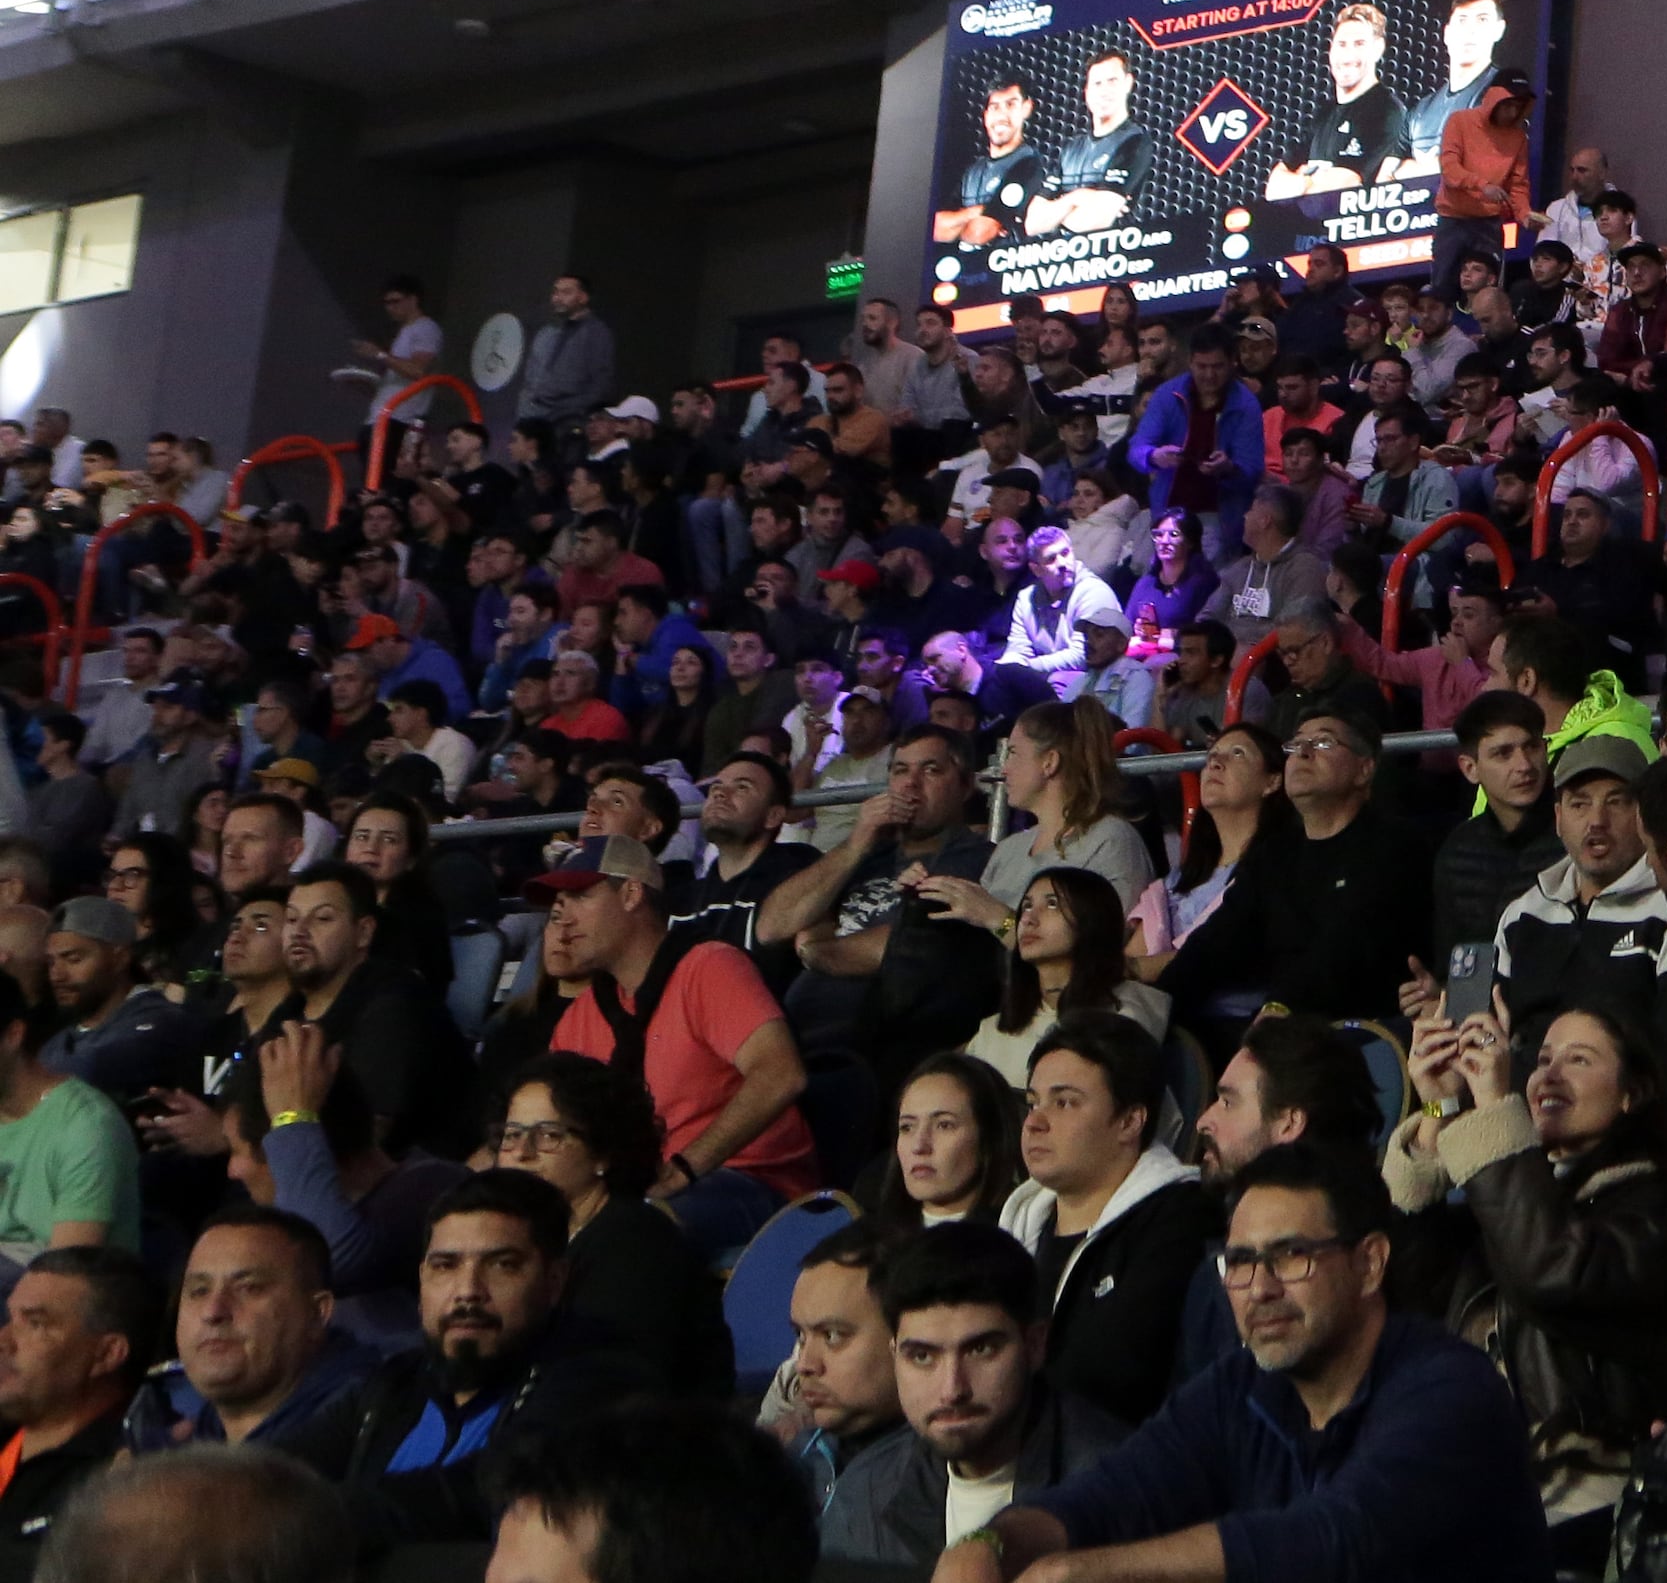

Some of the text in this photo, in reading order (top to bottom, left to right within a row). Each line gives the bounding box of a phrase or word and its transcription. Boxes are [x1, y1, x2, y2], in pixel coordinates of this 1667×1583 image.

[1152, 7, 1240, 36] STARTING
[1243, 0, 1268, 18] AT
[1198, 109, 1248, 144] VS
[1339, 183, 1431, 215] RUIZ ESP
[1323, 209, 1409, 242] TELLO
[988, 227, 1172, 272] CHINGOTTO ARG
[1001, 254, 1128, 295] NAVARRO
[1127, 259, 1154, 275] ESP
[1131, 270, 1229, 301] QUARTER
